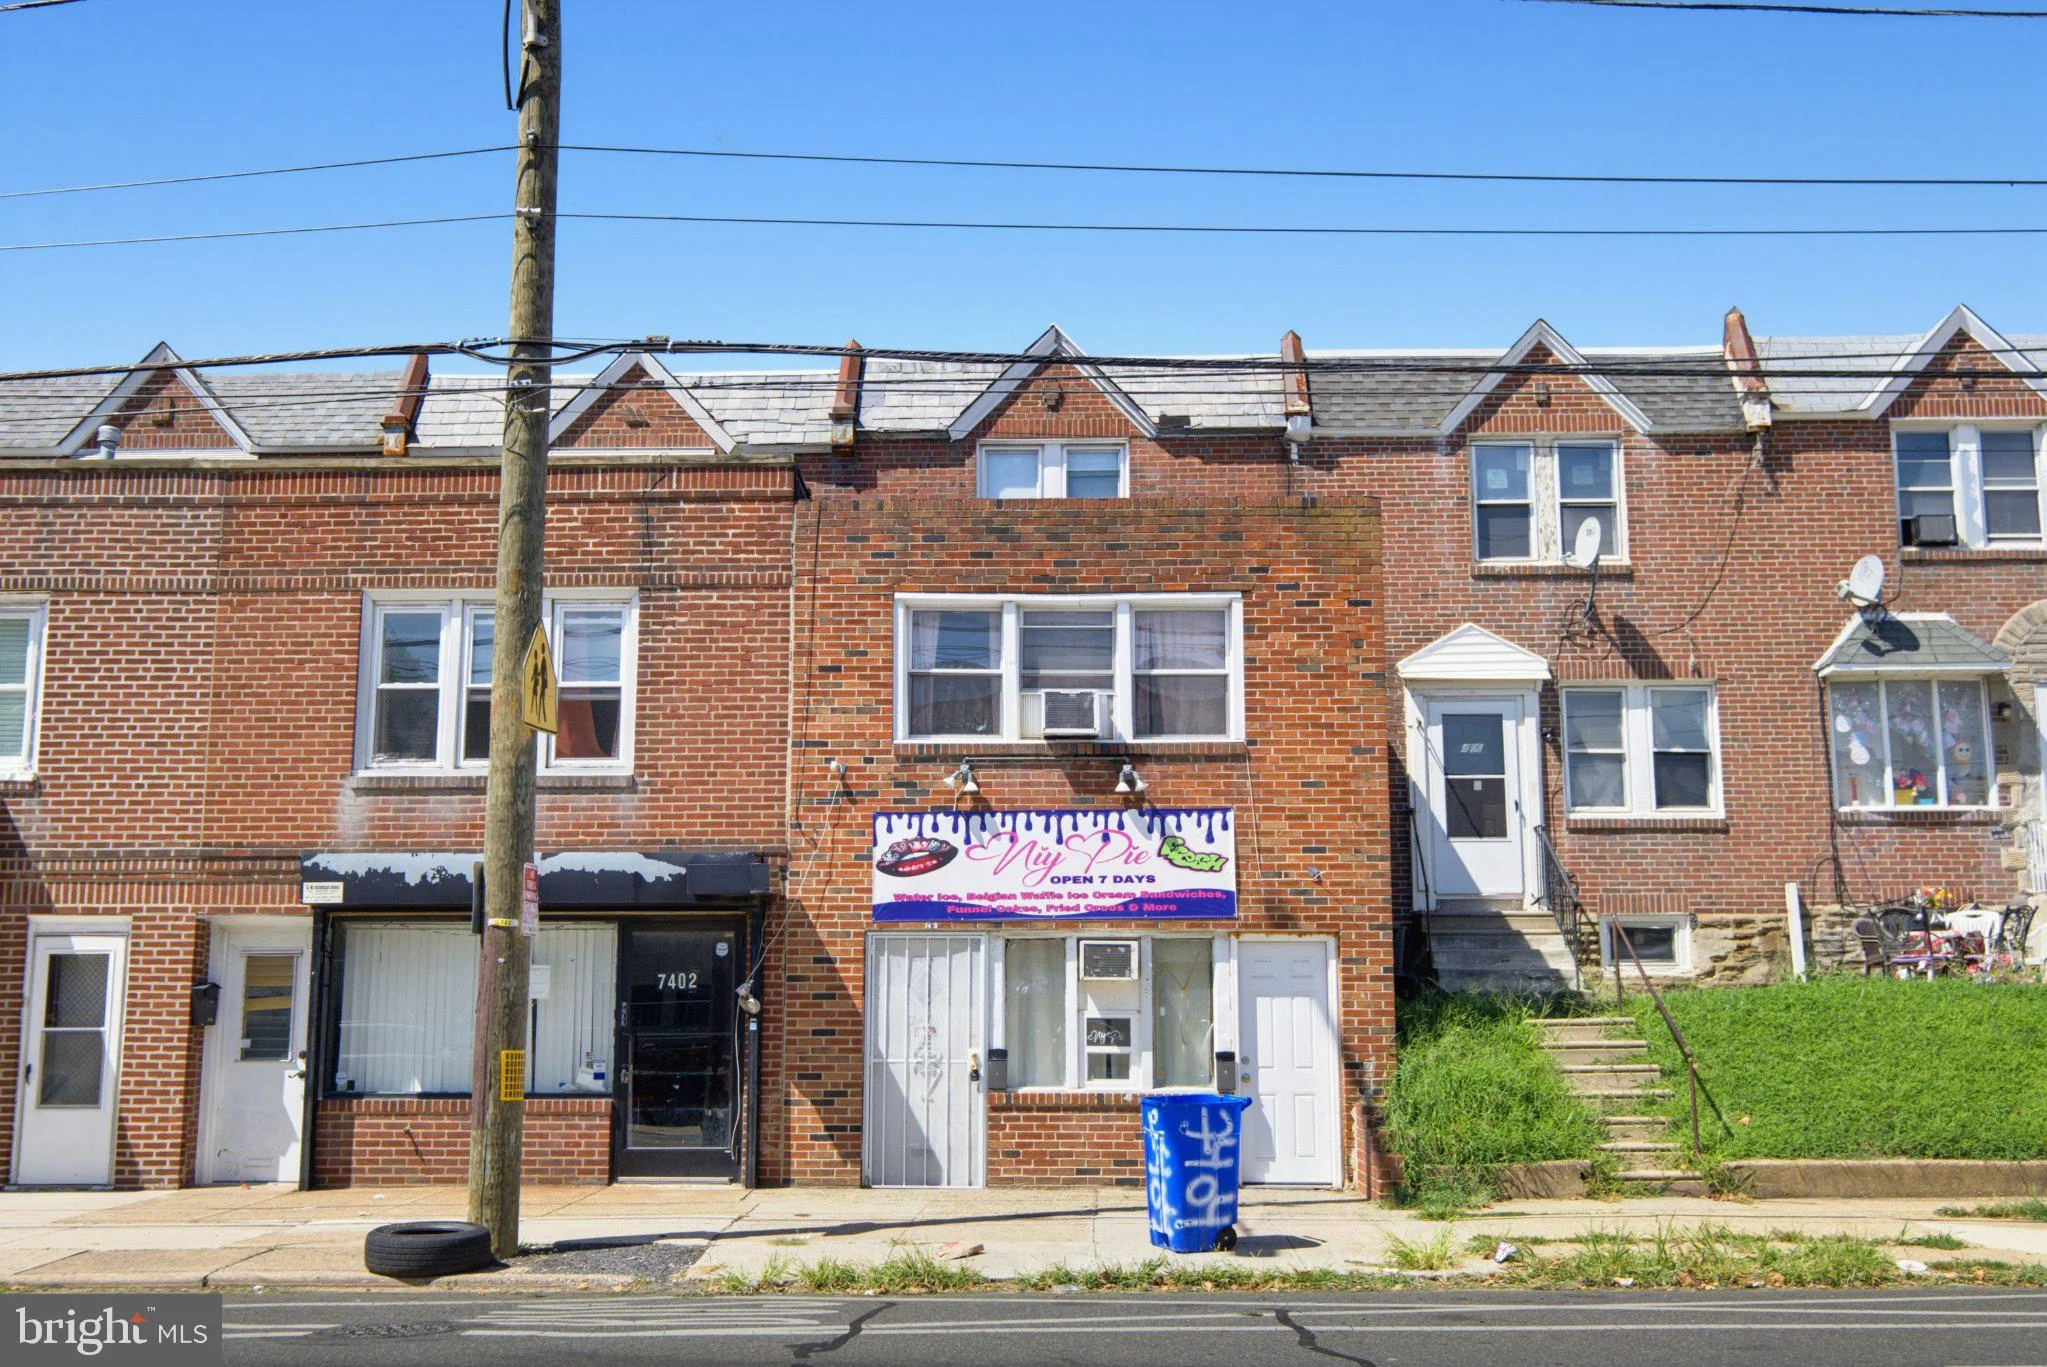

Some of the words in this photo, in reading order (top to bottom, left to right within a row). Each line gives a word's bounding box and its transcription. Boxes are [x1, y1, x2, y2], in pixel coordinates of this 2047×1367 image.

[1064, 829, 1151, 874] Pie
[1050, 875, 1094, 884] OPEN
[1100, 875, 1108, 884] 7
[1113, 875, 1156, 884] DAYS
[893, 893, 934, 902] Water
[966, 892, 1017, 902] Belgian
[1020, 891, 1063, 901] Waffle
[1067, 891, 1089, 900] Ice
[1092, 891, 1137, 900] Cream
[1140, 889, 1227, 899] Sandwiches,
[946, 904, 992, 914] Funnel
[996, 904, 1042, 914] Cakes,
[1046, 903, 1081, 912] Fried
[1084, 903, 1124, 912] Oreos
[1129, 903, 1140, 912] &
[1143, 903, 1177, 912] More
[657, 972, 698, 990] 7402
